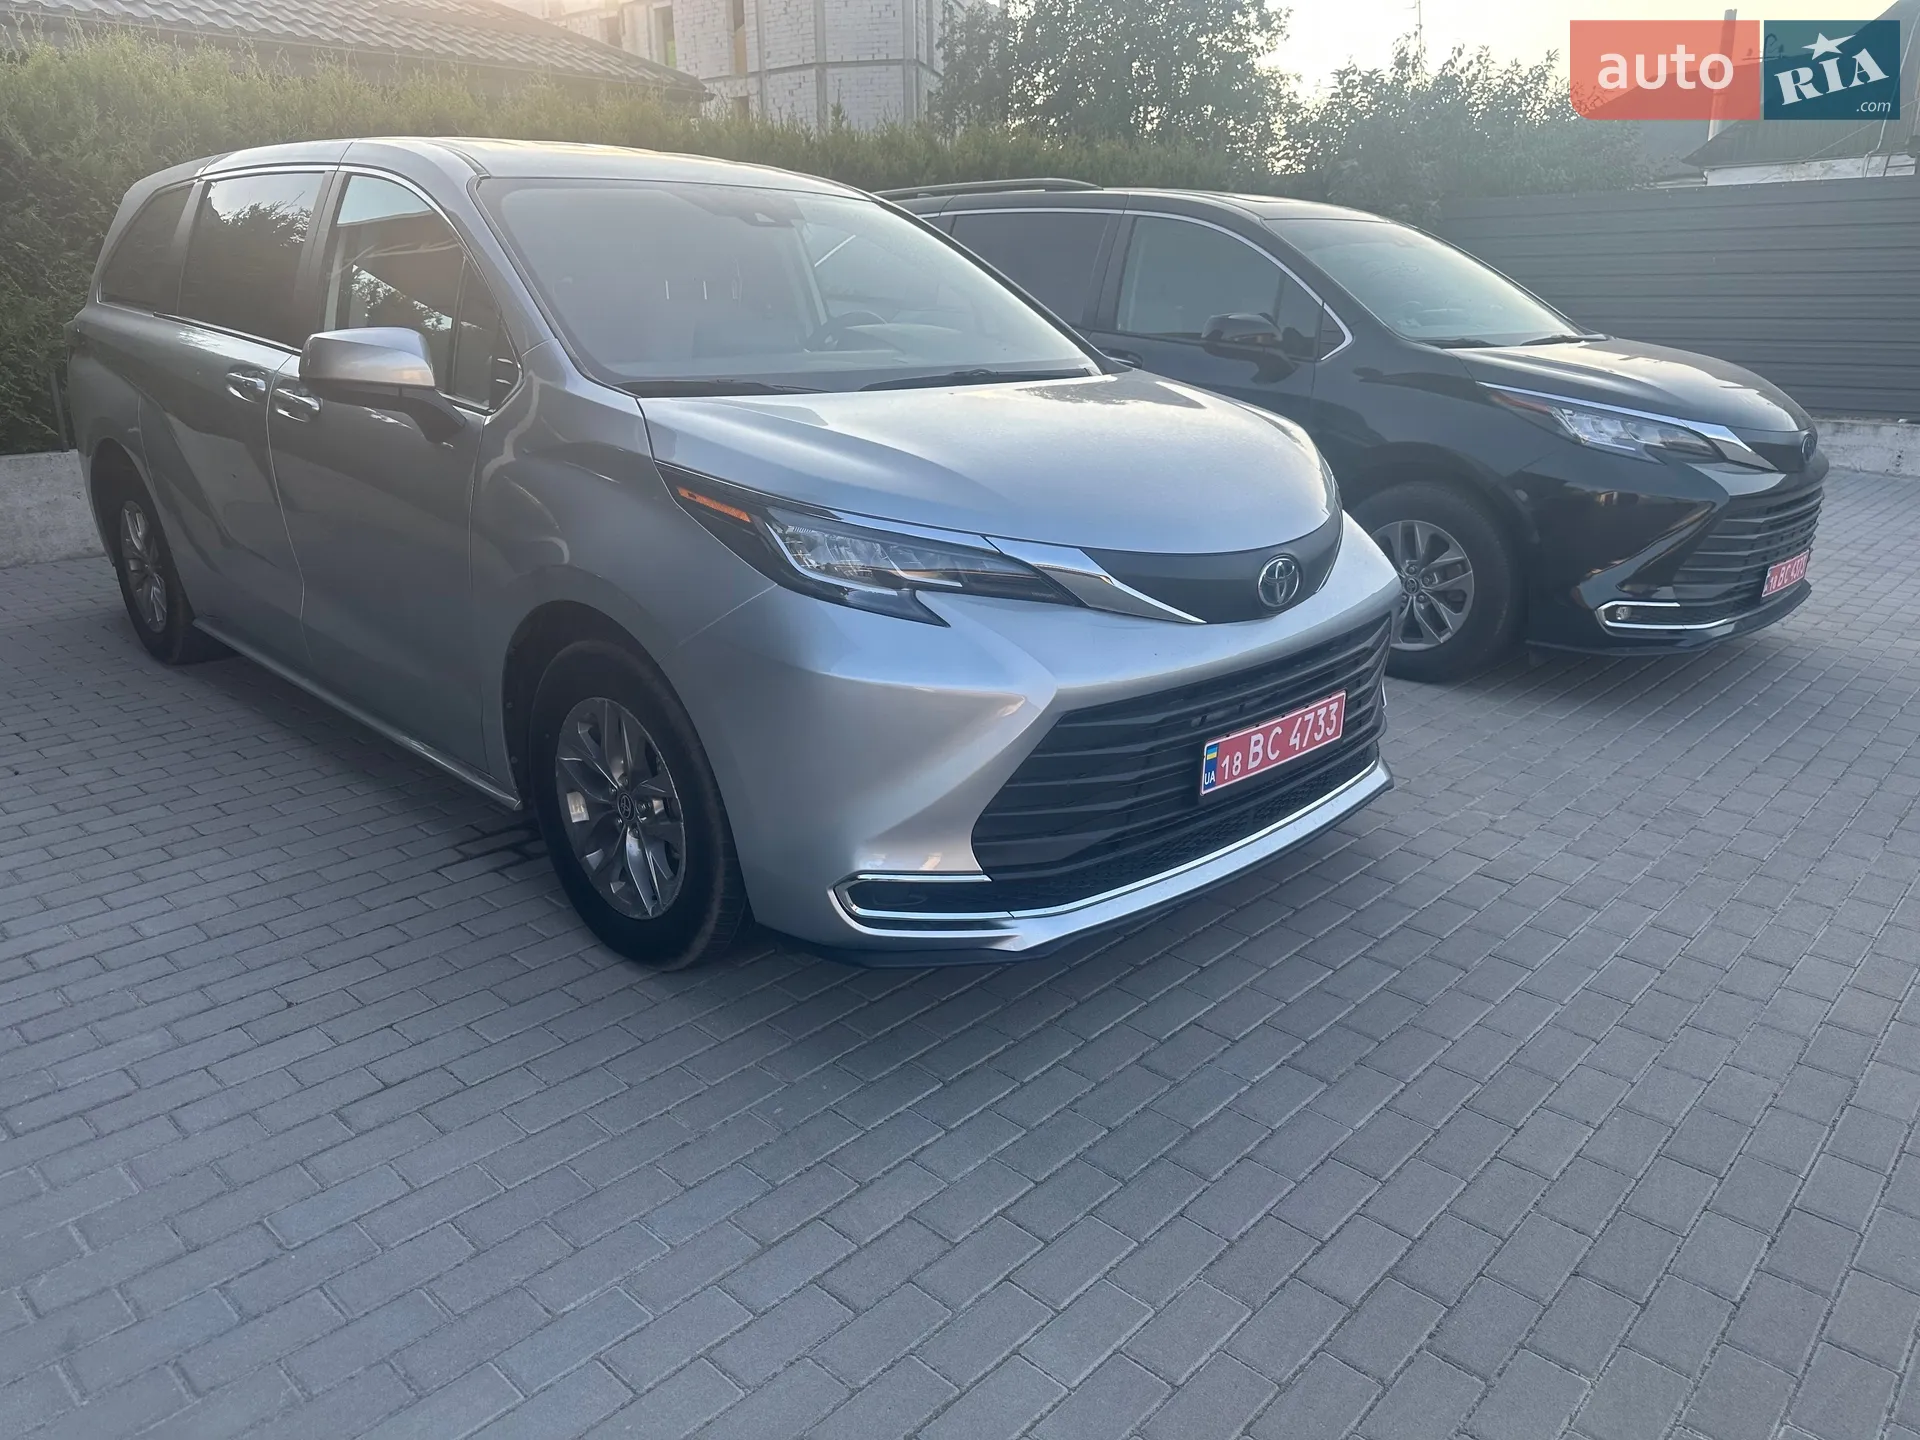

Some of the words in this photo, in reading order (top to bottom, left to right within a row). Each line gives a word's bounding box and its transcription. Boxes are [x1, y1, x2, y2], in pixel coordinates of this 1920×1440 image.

[1221, 751, 1242, 780] 18
[1248, 726, 1283, 770] BC
[1289, 702, 1339, 751] 4733
[1204, 771, 1216, 785] UA
